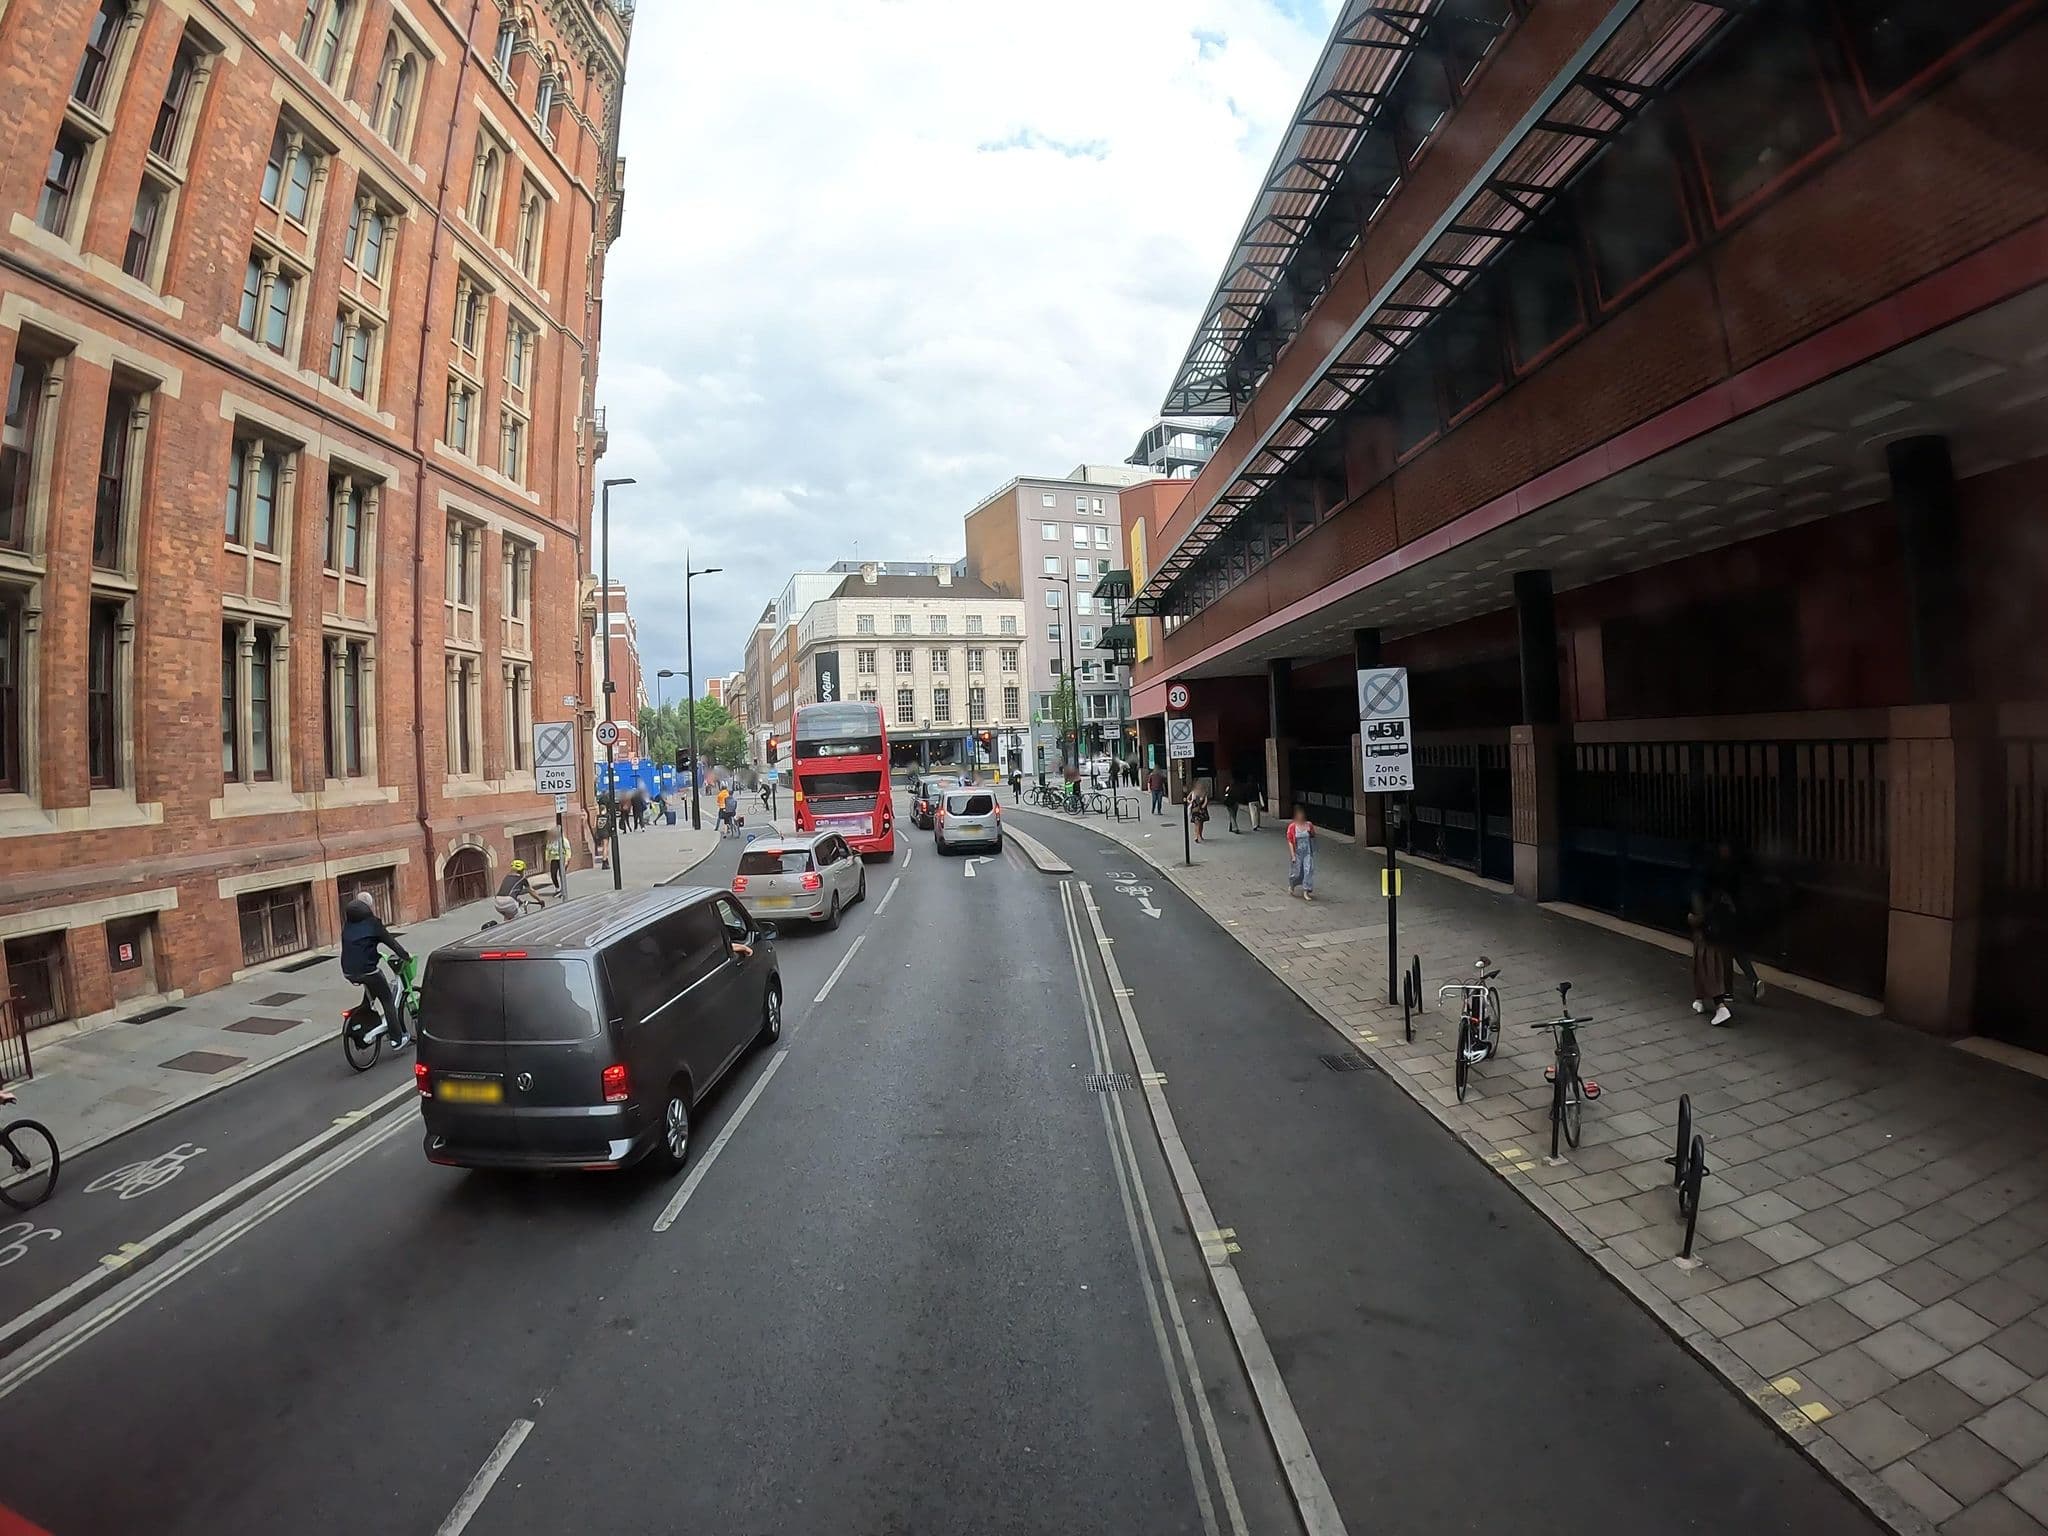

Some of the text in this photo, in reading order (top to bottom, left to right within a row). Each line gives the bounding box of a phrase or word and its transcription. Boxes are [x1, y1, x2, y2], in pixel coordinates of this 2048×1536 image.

[1171, 691, 1187, 703] 30
[599, 728, 616, 739] 30
[1382, 722, 1400, 736] 5T
[545, 770, 566, 778] Zone
[1375, 764, 1400, 773] Zone
[540, 779, 572, 790] ENDS
[1368, 775, 1408, 788] ENDS
